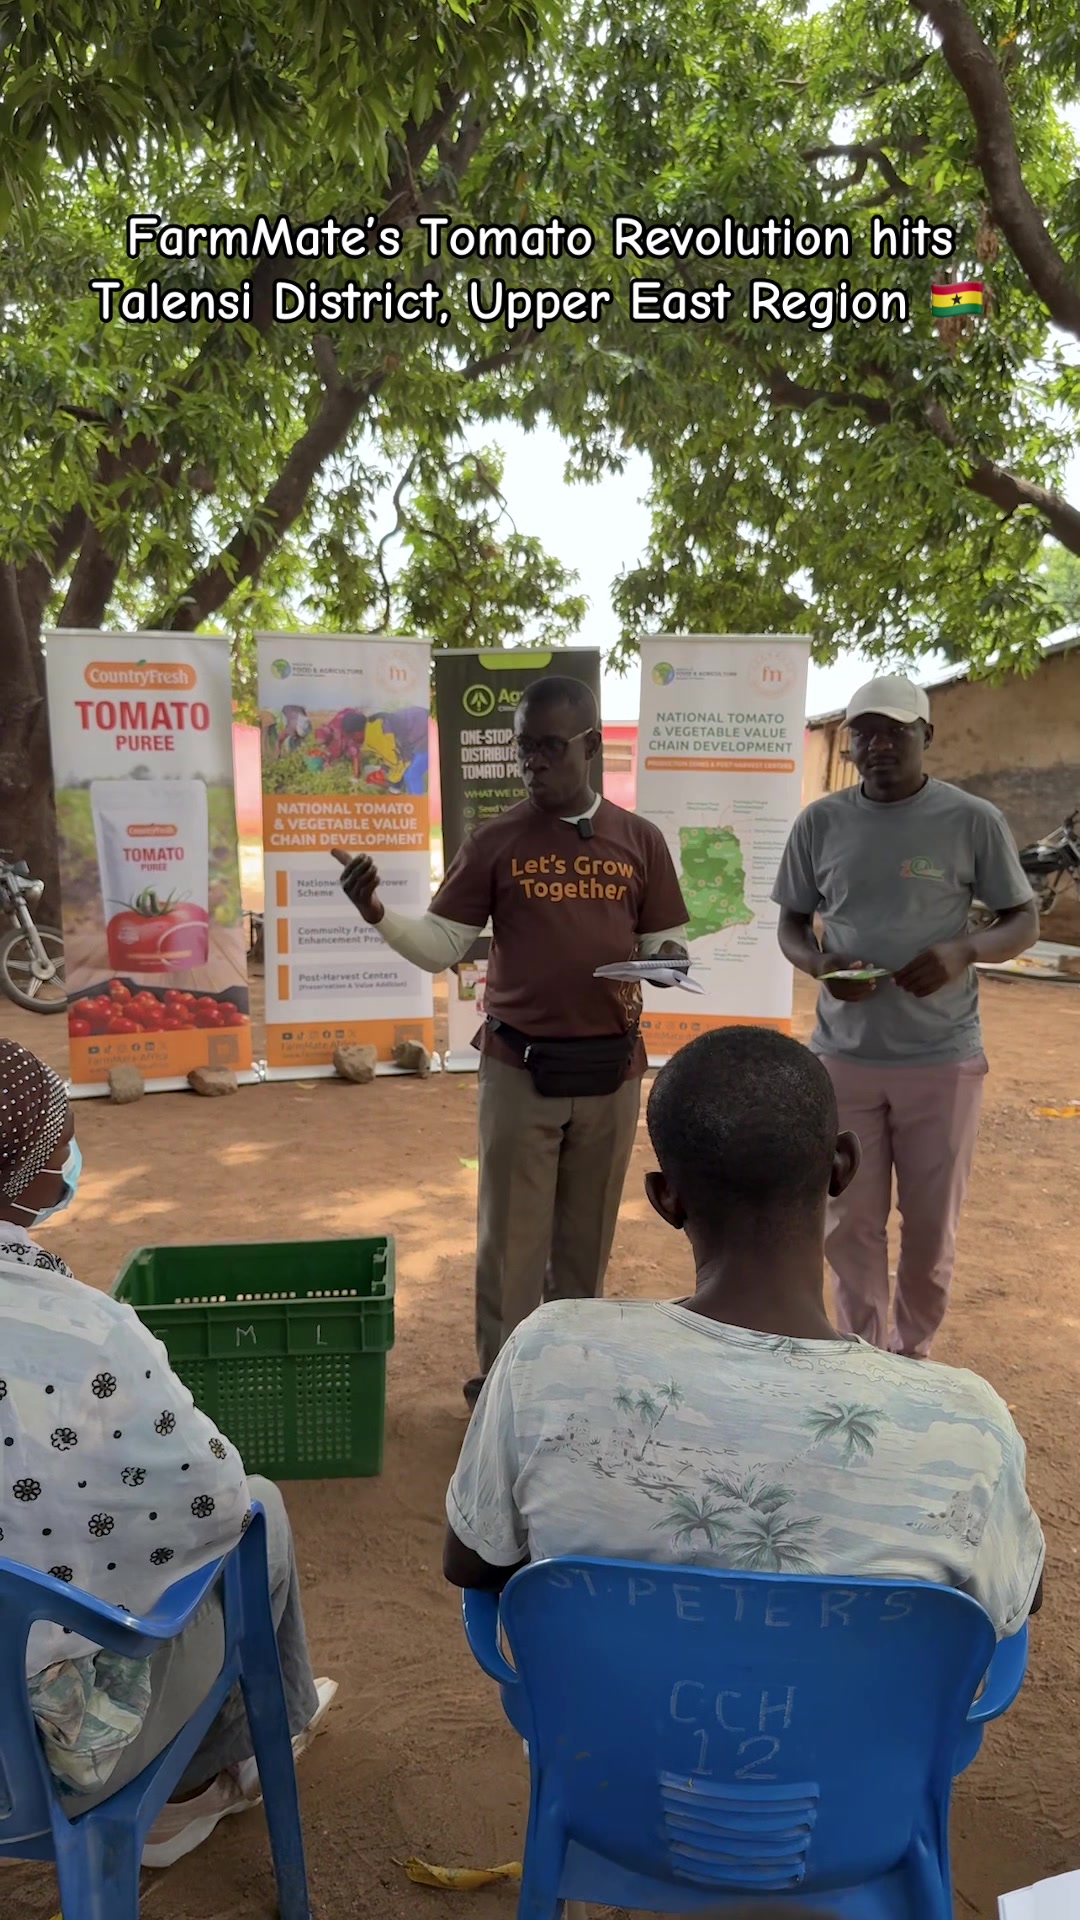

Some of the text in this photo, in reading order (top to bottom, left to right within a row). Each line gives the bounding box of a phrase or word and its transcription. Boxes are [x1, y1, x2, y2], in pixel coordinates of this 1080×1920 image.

[89, 668, 189, 687] CountryFresh
[74, 700, 211, 731] TOMATO
[656, 712, 785, 724] NATIONAL TOMATO
[460, 729, 513, 745] ONE-STOP
[652, 726, 787, 739] & VEGETABLE VALUE
[115, 735, 176, 751] PUREE
[648, 740, 793, 753] CHAIN DEVELOPMENT
[461, 746, 520, 763] DISTRIBUT
[461, 762, 522, 779] TOMATO PR
[464, 788, 493, 799] WHAT
[494, 788, 512, 798] WE
[276, 802, 415, 815] NATIONAL TOMATO
[273, 818, 418, 831] & VEGETABLE VALUE
[269, 833, 424, 846] CHAIN DEVELOPMENT
[122, 847, 185, 862] TOMATO
[140, 863, 168, 872] PUREE
[511, 854, 634, 879] Let's Grow
[297, 879, 341, 888] Nationwi
[519, 877, 627, 902] Together
[297, 888, 334, 898] Scheme
[298, 926, 376, 937] Community Farm
[298, 935, 385, 946] Enhancement Prog
[298, 971, 398, 982] Post-Harvest Centers
[235, 1323, 329, 1348] M L
[669, 1679, 798, 1733] CCH
